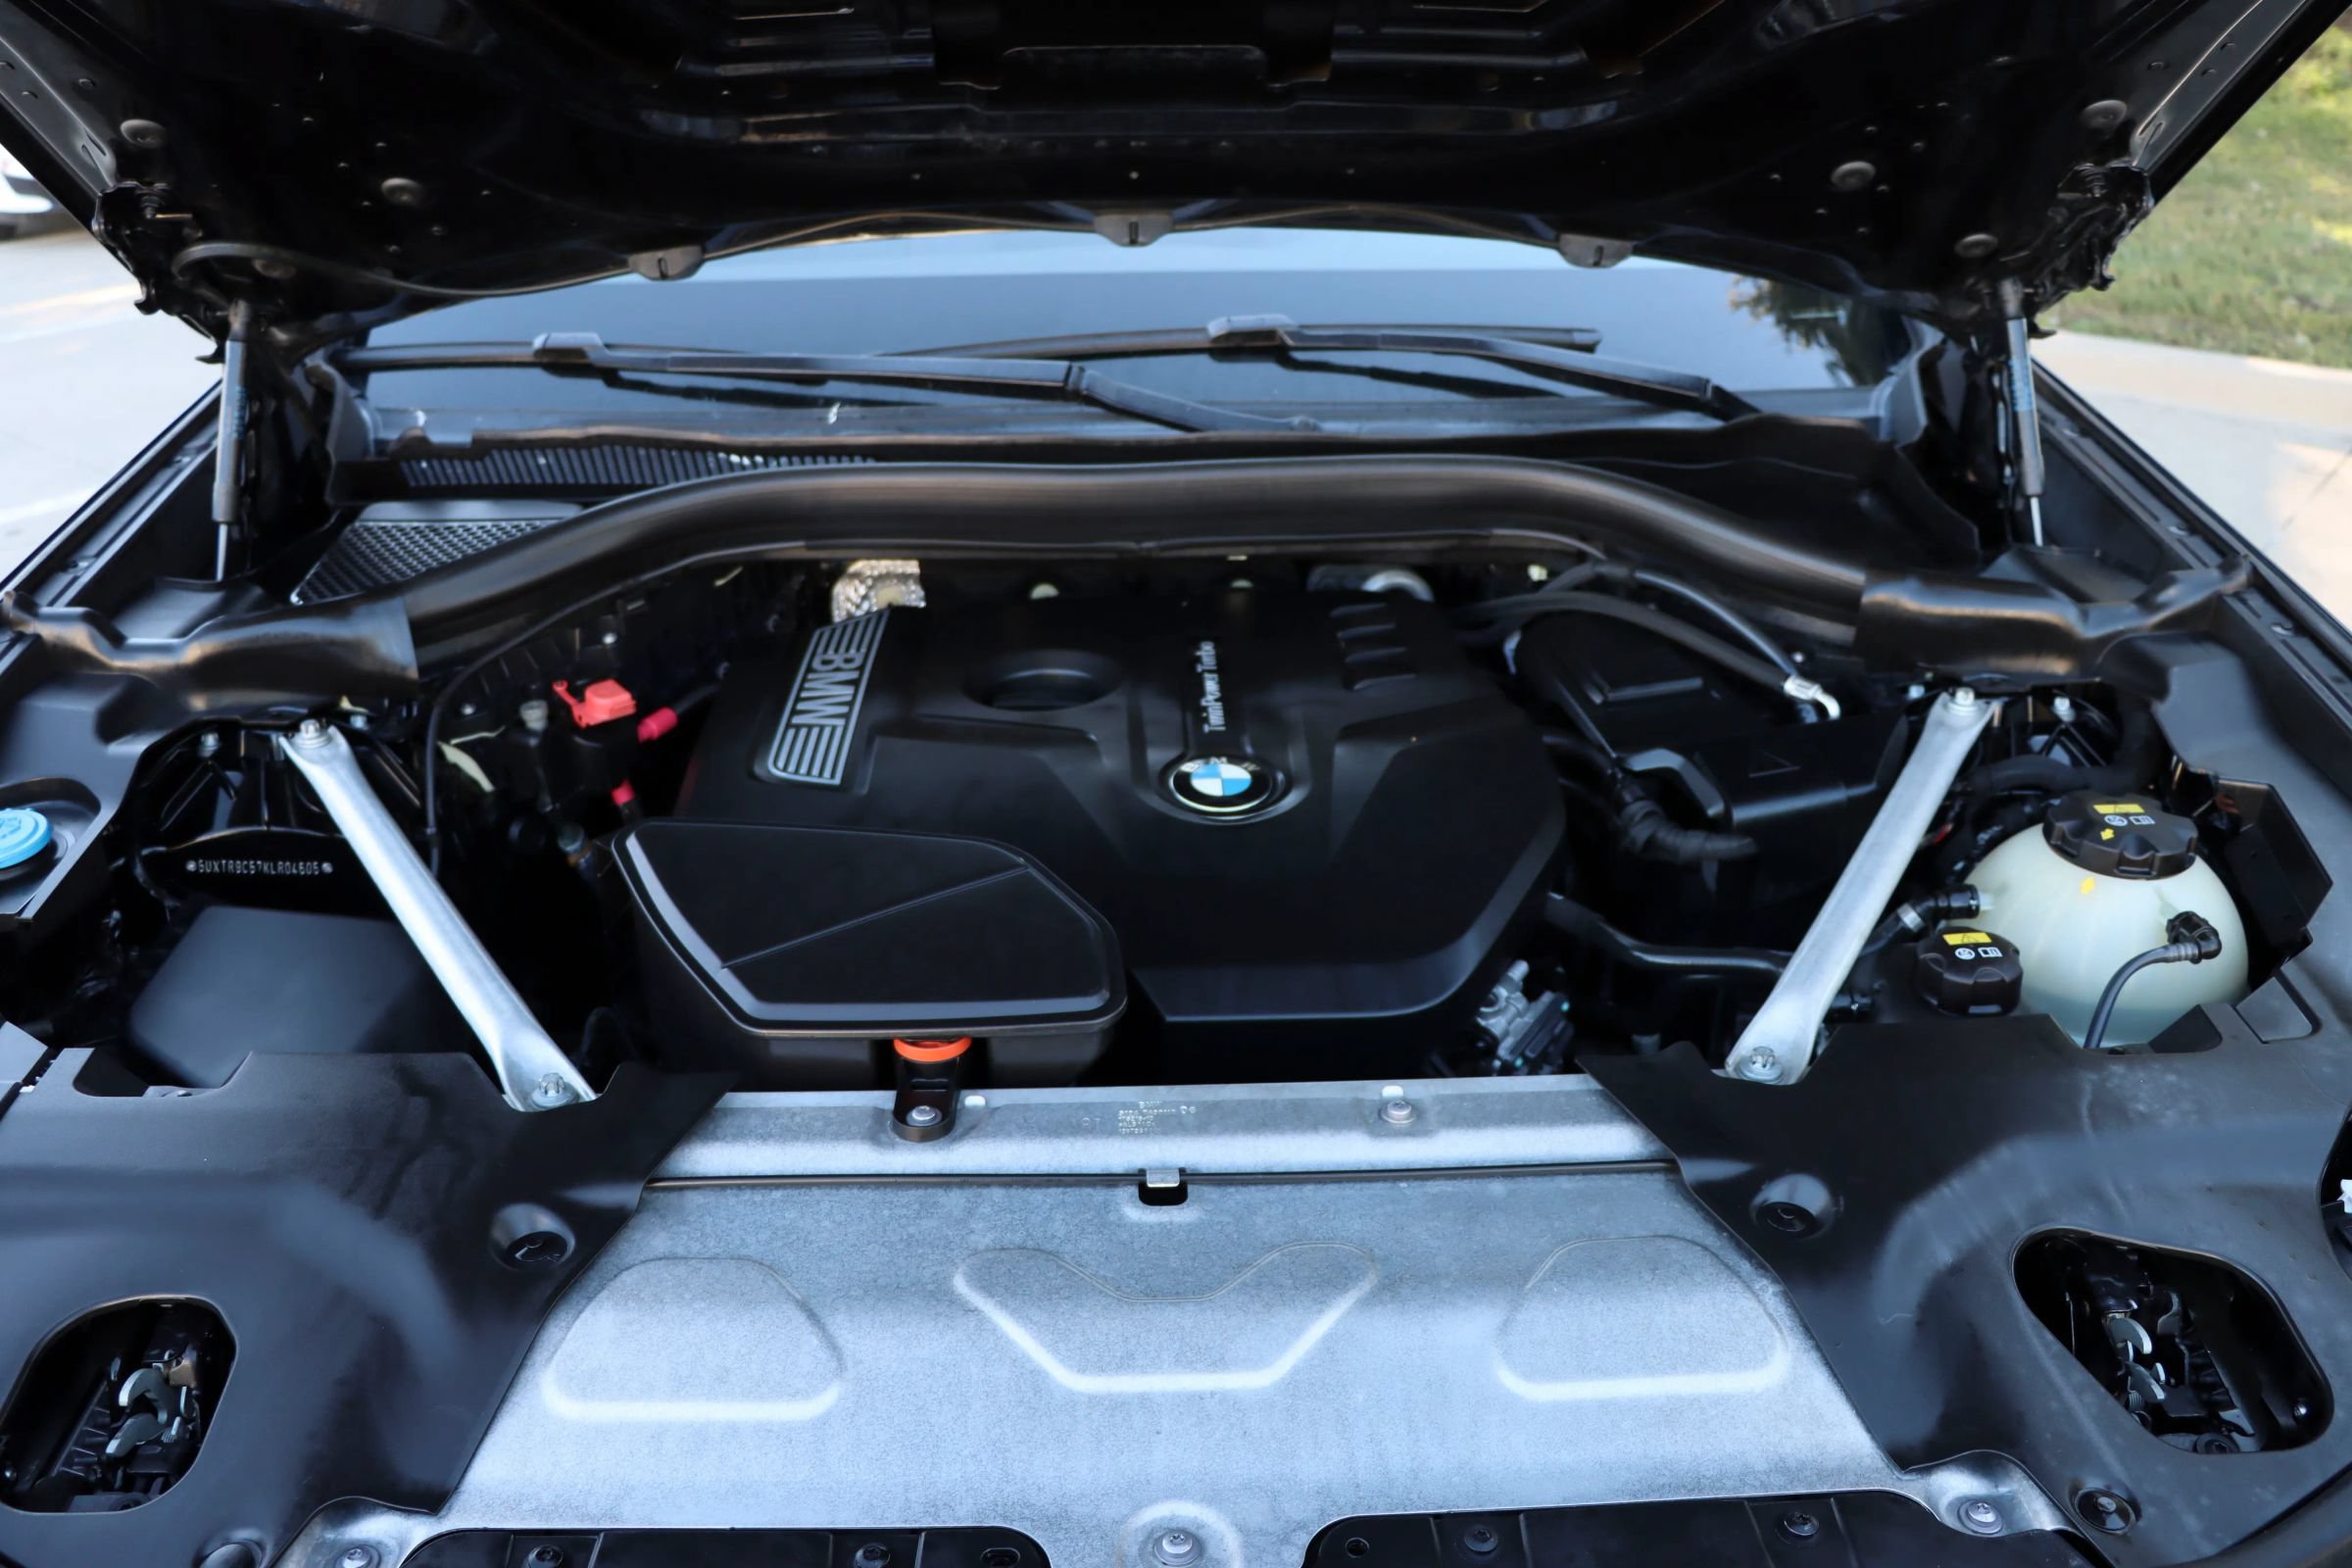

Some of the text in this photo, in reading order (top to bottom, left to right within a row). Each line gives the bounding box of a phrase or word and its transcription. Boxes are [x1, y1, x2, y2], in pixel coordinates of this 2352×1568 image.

[791, 650, 866, 726] BMW
[1195, 641, 1226, 733] TwinPower Turbo
